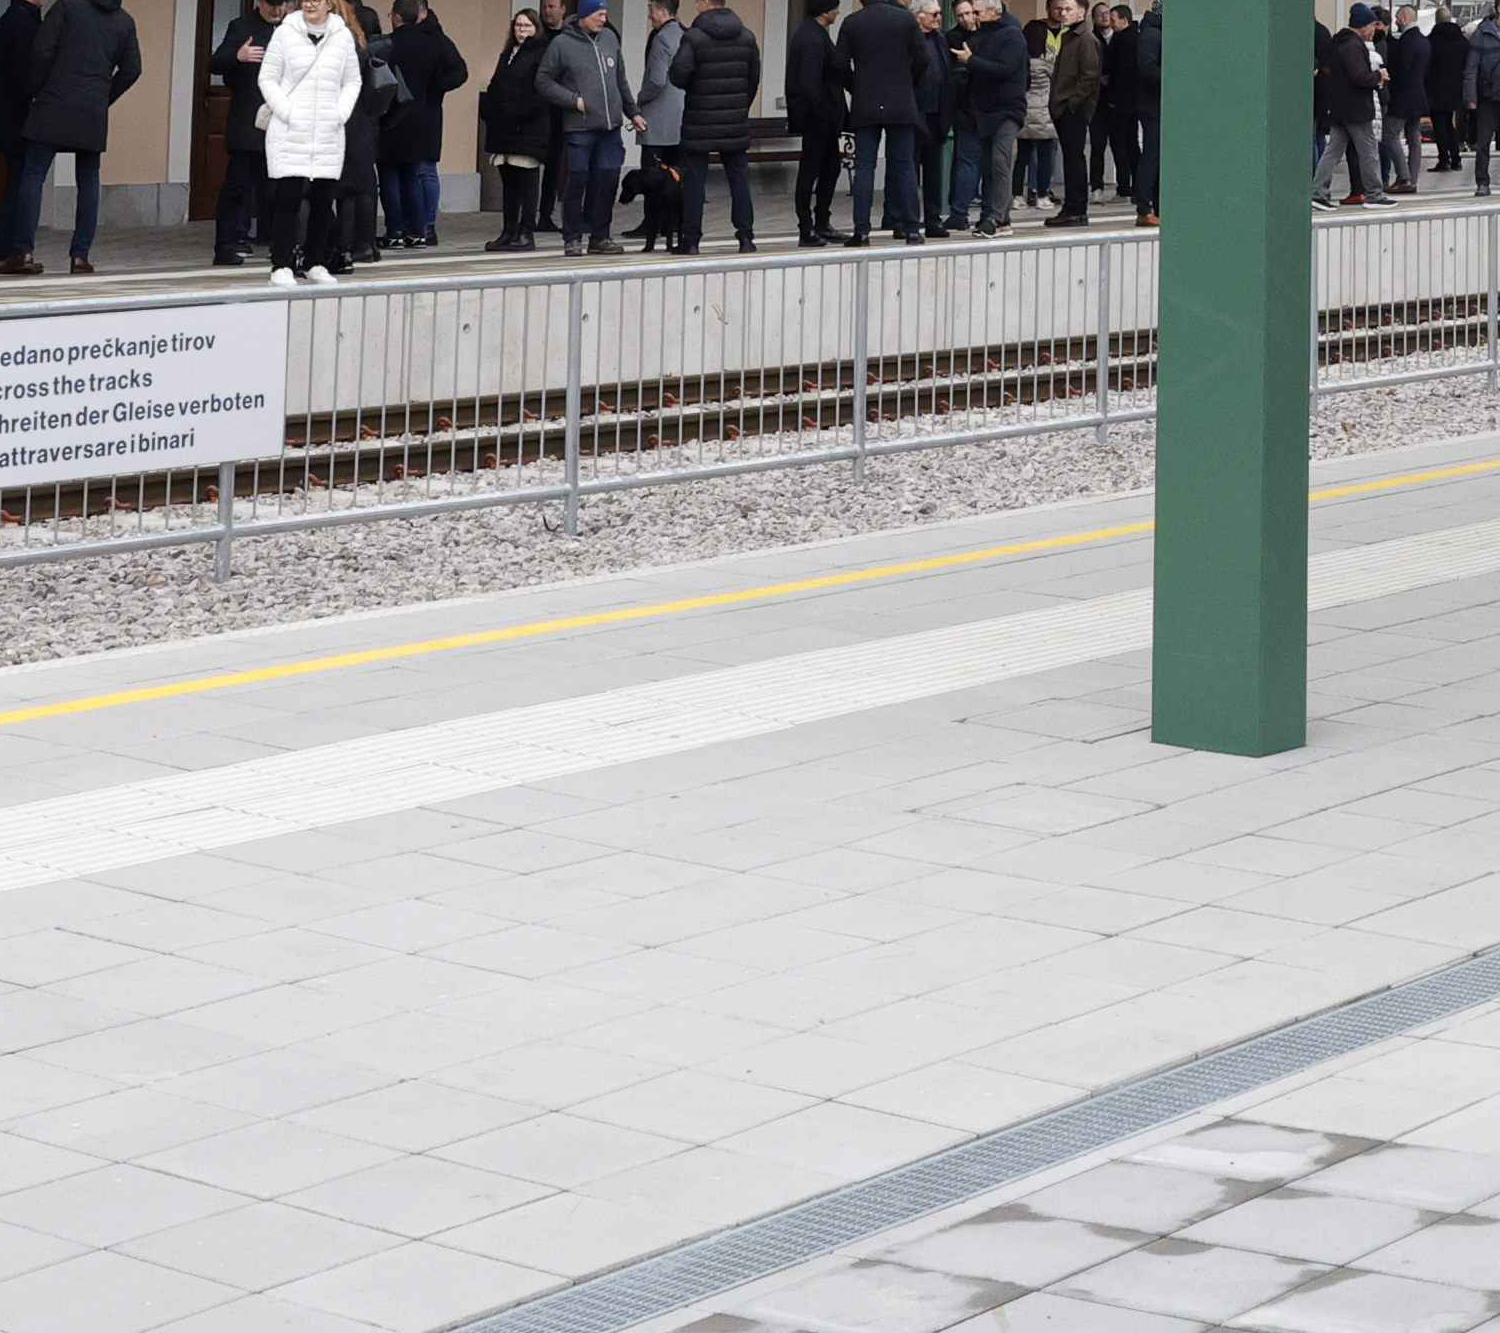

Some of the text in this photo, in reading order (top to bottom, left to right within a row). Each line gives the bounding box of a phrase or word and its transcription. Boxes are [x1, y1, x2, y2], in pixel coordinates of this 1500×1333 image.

[67, 334, 168, 366] prečkanje
[171, 332, 216, 353] tirov
[52, 374, 86, 396] the
[88, 368, 153, 393] tracks
[75, 405, 110, 427] der
[112, 399, 176, 423] Gleise
[178, 392, 265, 416] verboten
[130, 434, 136, 454] i
[138, 427, 195, 453] binari
